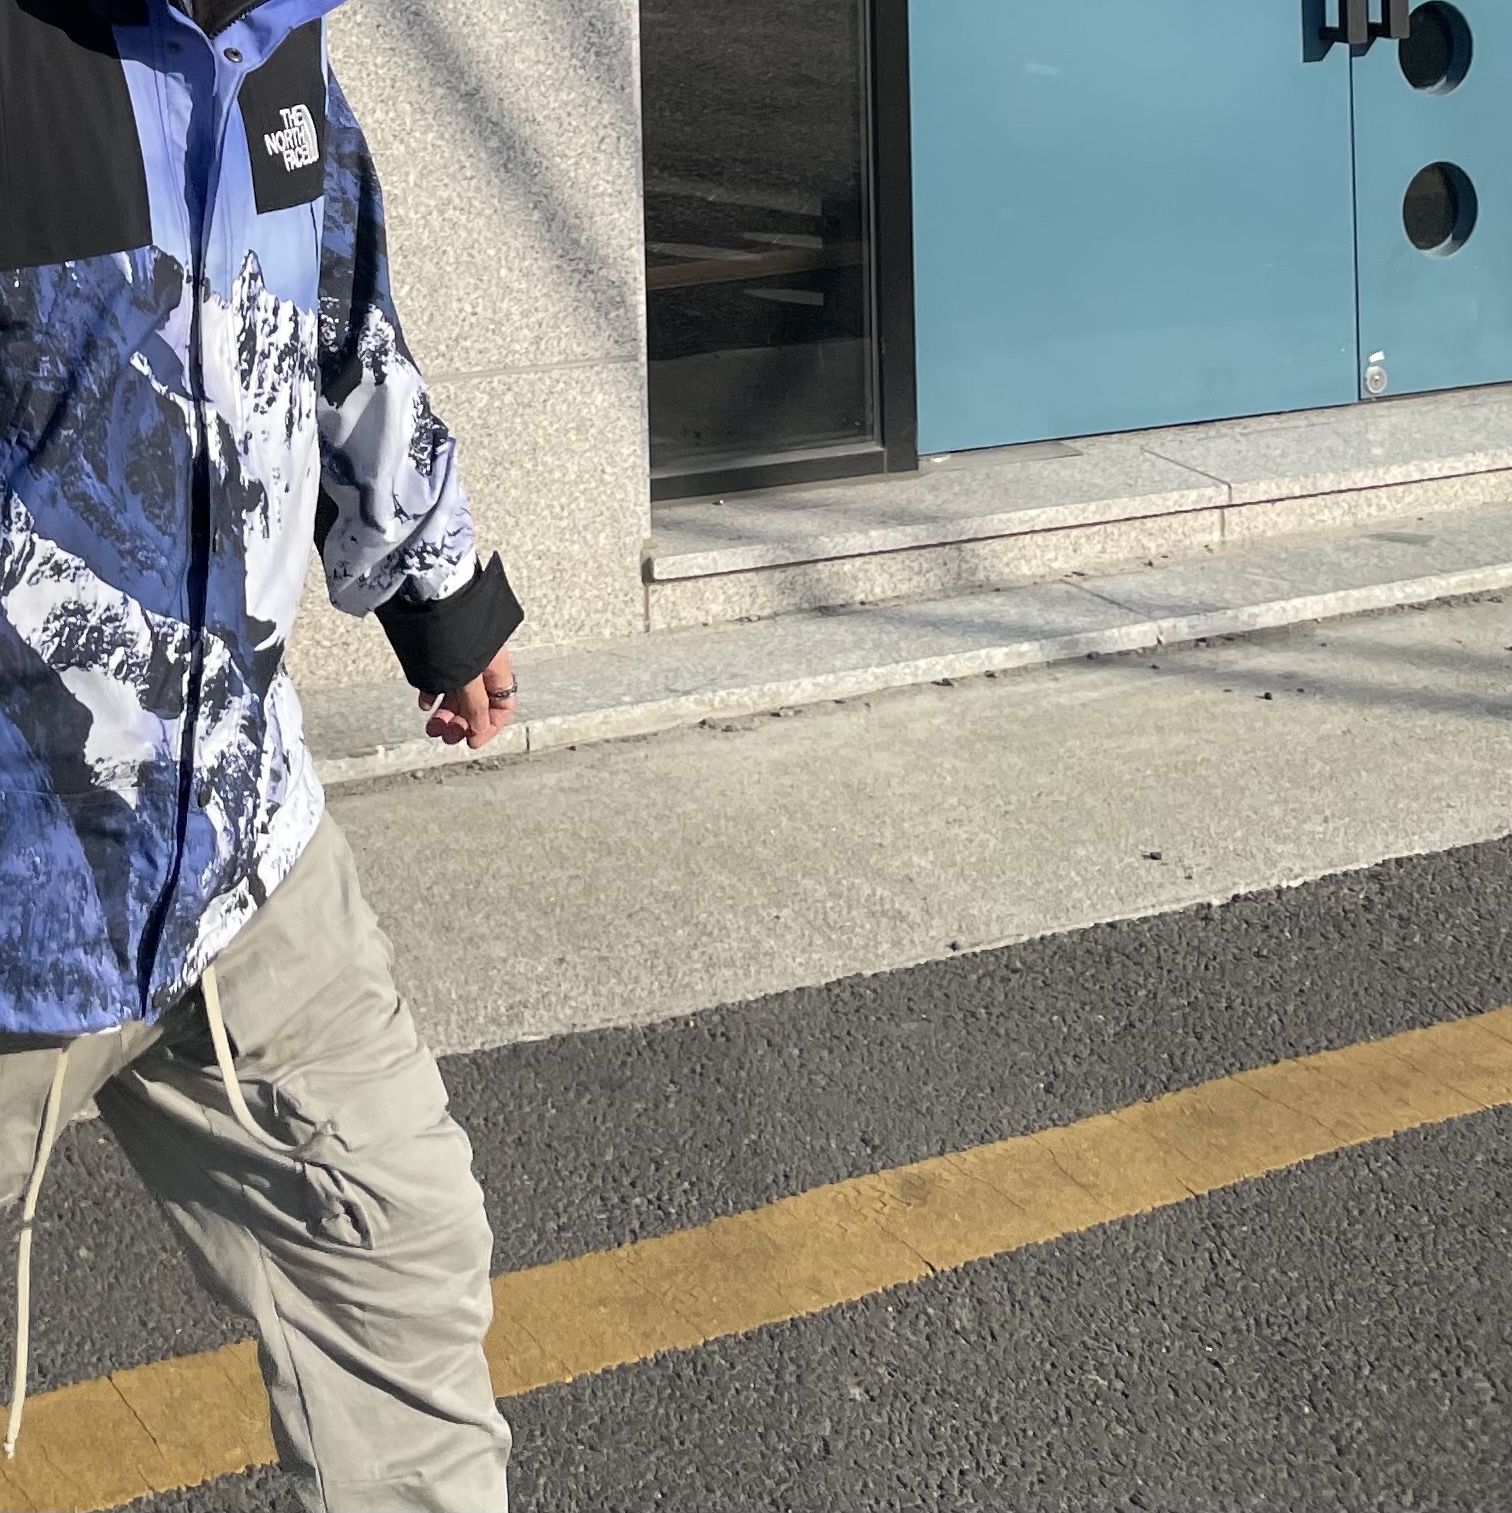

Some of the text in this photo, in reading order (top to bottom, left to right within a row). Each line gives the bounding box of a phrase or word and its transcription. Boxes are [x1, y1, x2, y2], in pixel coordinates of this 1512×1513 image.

[279, 104, 305, 129] THE
[263, 125, 307, 156] NORTH
[282, 143, 309, 172] FACE
